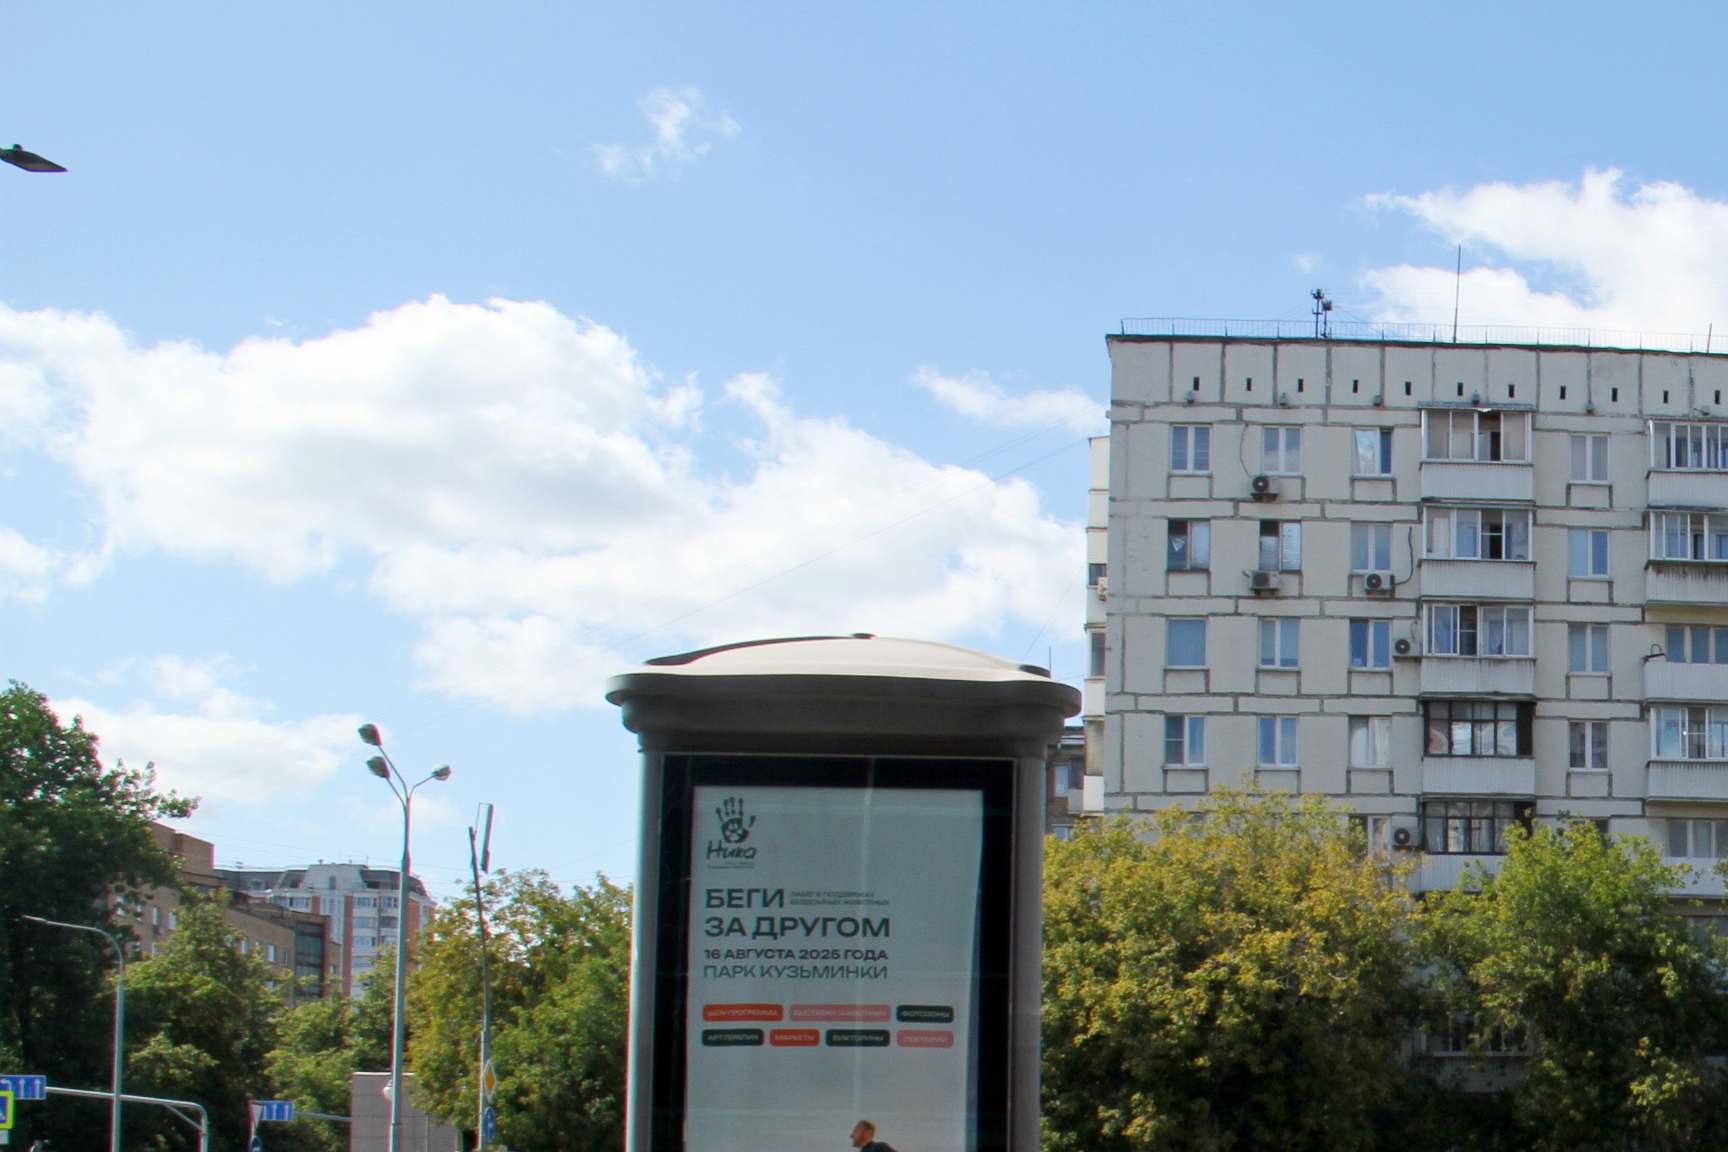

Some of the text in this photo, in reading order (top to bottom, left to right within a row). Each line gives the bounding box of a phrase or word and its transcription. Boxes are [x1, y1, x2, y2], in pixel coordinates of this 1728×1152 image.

[705, 888, 785, 909] БЕГИ
[704, 916, 891, 941] ЗА ДРУГОМ
[704, 948, 889, 961] 16 АВГУСТА 2025 ГОДА
[703, 964, 888, 979] ПАРК КУЗЬМИНКИ
[775, 1033, 816, 1042] МАРКЕТЫ
